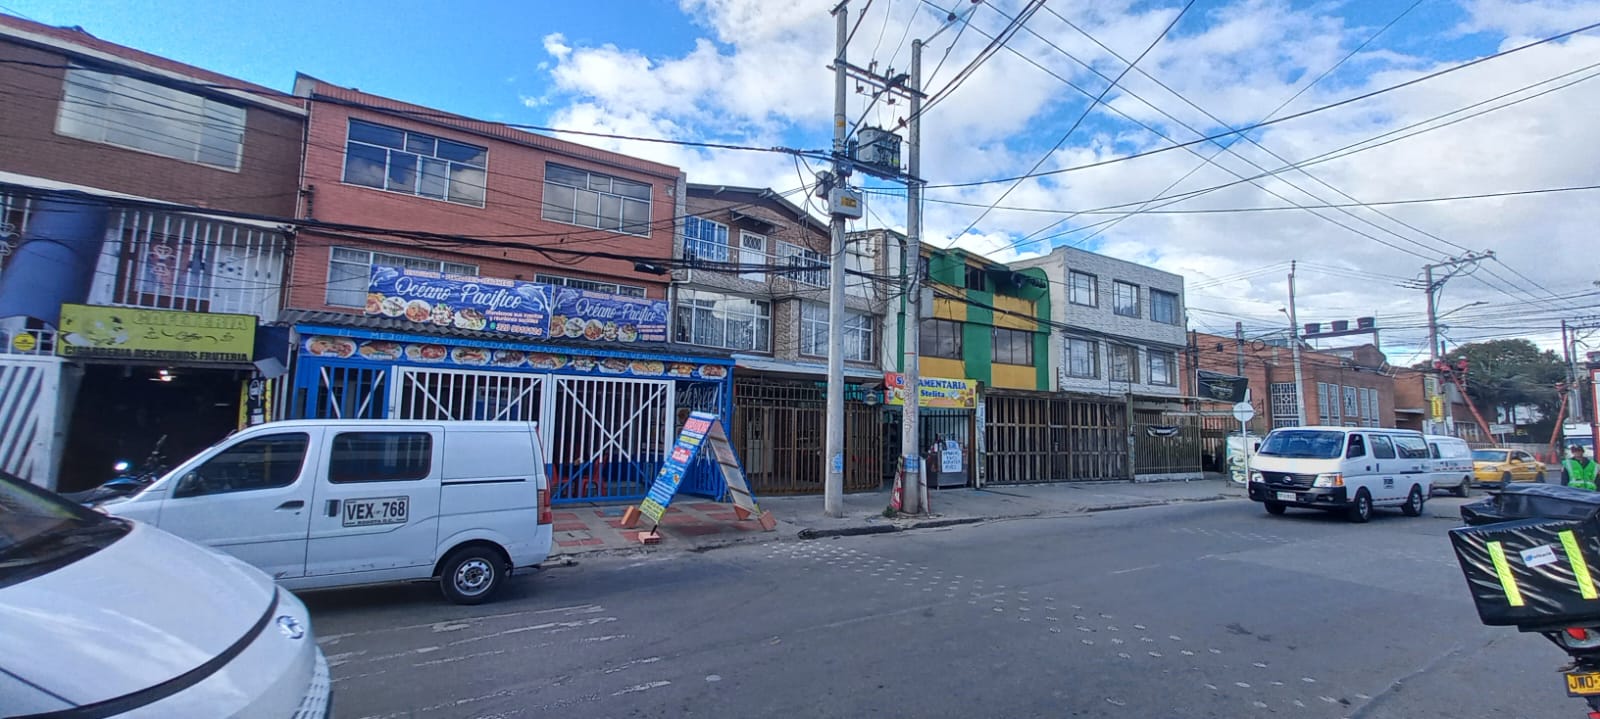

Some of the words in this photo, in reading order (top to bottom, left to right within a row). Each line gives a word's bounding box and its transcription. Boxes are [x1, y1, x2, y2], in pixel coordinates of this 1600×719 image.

[395, 276, 451, 301] Océano
[576, 297, 616, 318] Océano
[197, 351, 247, 361] FRUTERIA
